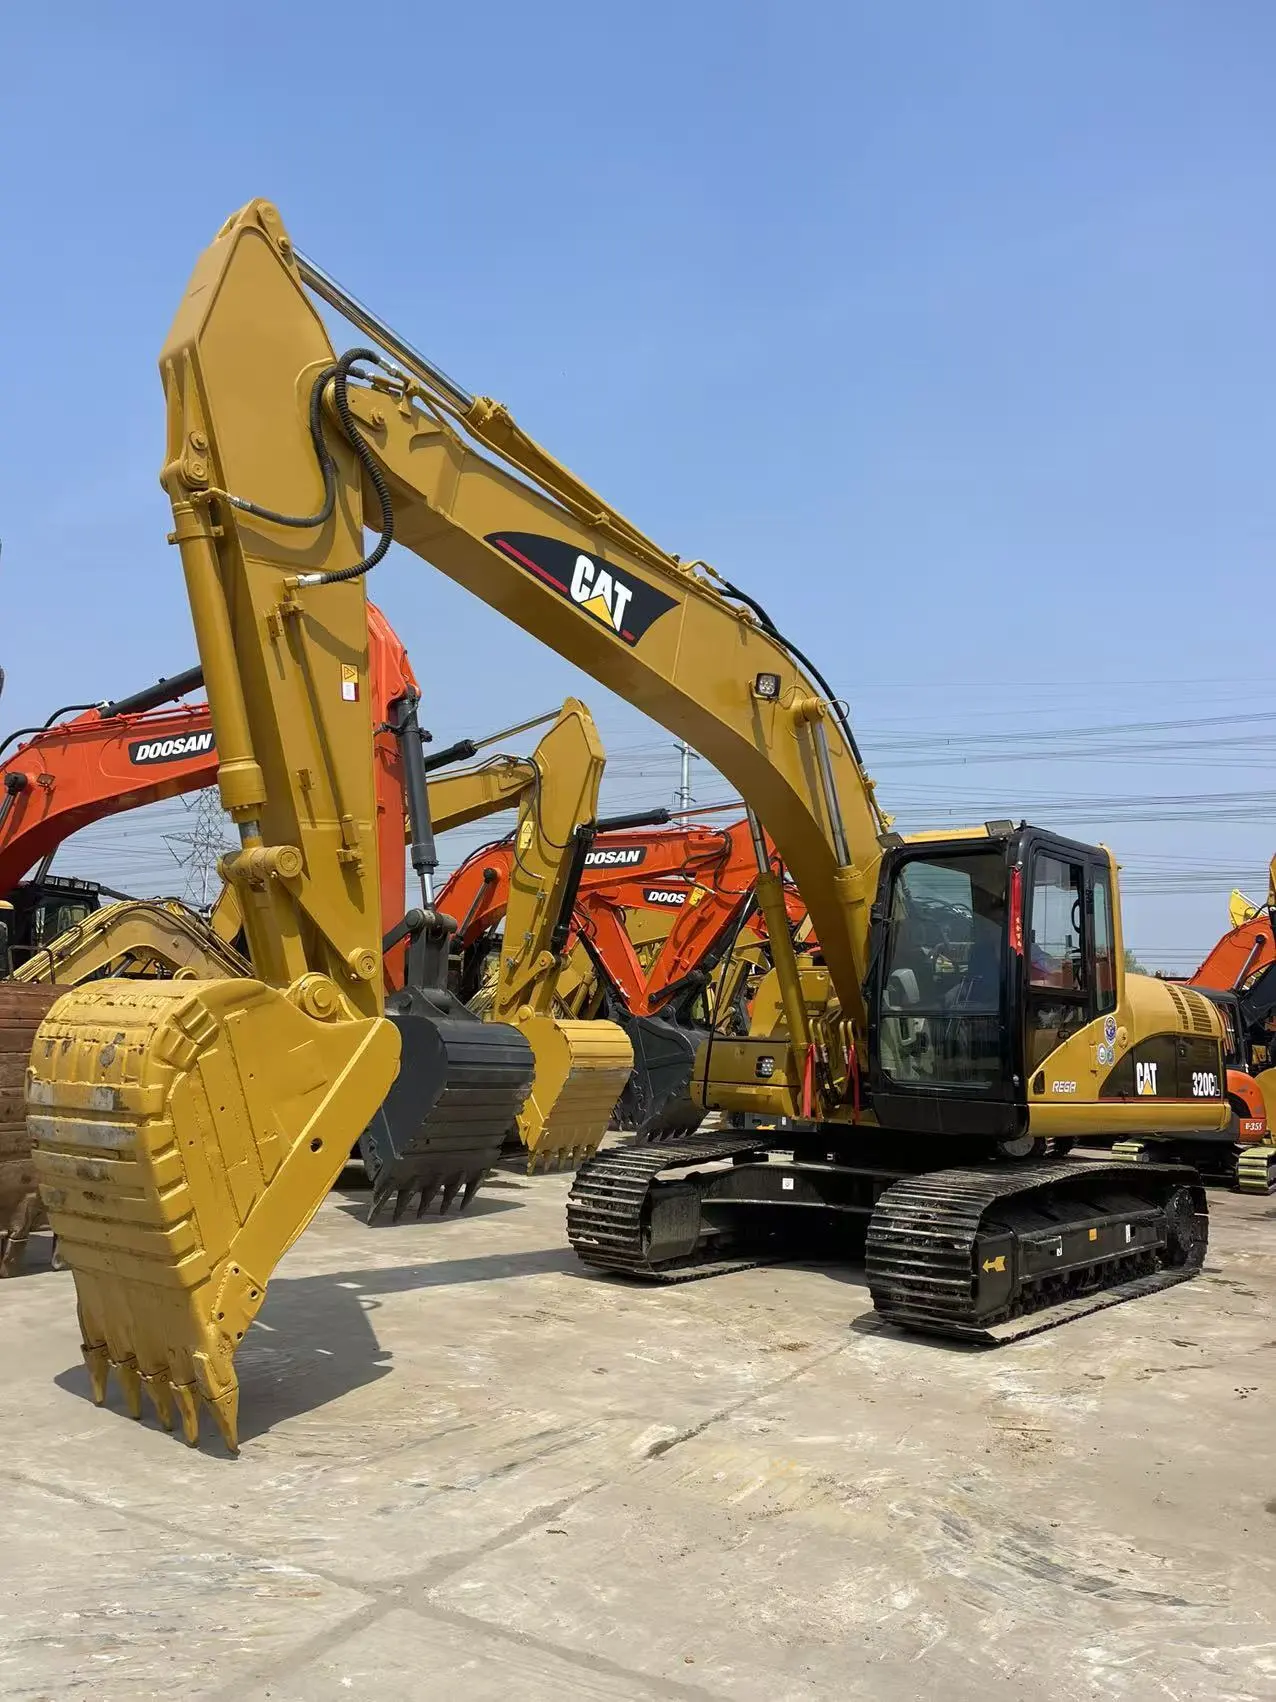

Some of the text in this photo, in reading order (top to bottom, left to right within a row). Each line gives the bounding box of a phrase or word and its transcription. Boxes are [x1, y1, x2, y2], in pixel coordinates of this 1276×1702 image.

[570, 554, 633, 632] CAT
[136, 733, 212, 761] DOOSAN
[584, 850, 640, 865] OOSAN
[648, 891, 686, 904] DOOS
[1136, 1062, 1157, 1095] CAT
